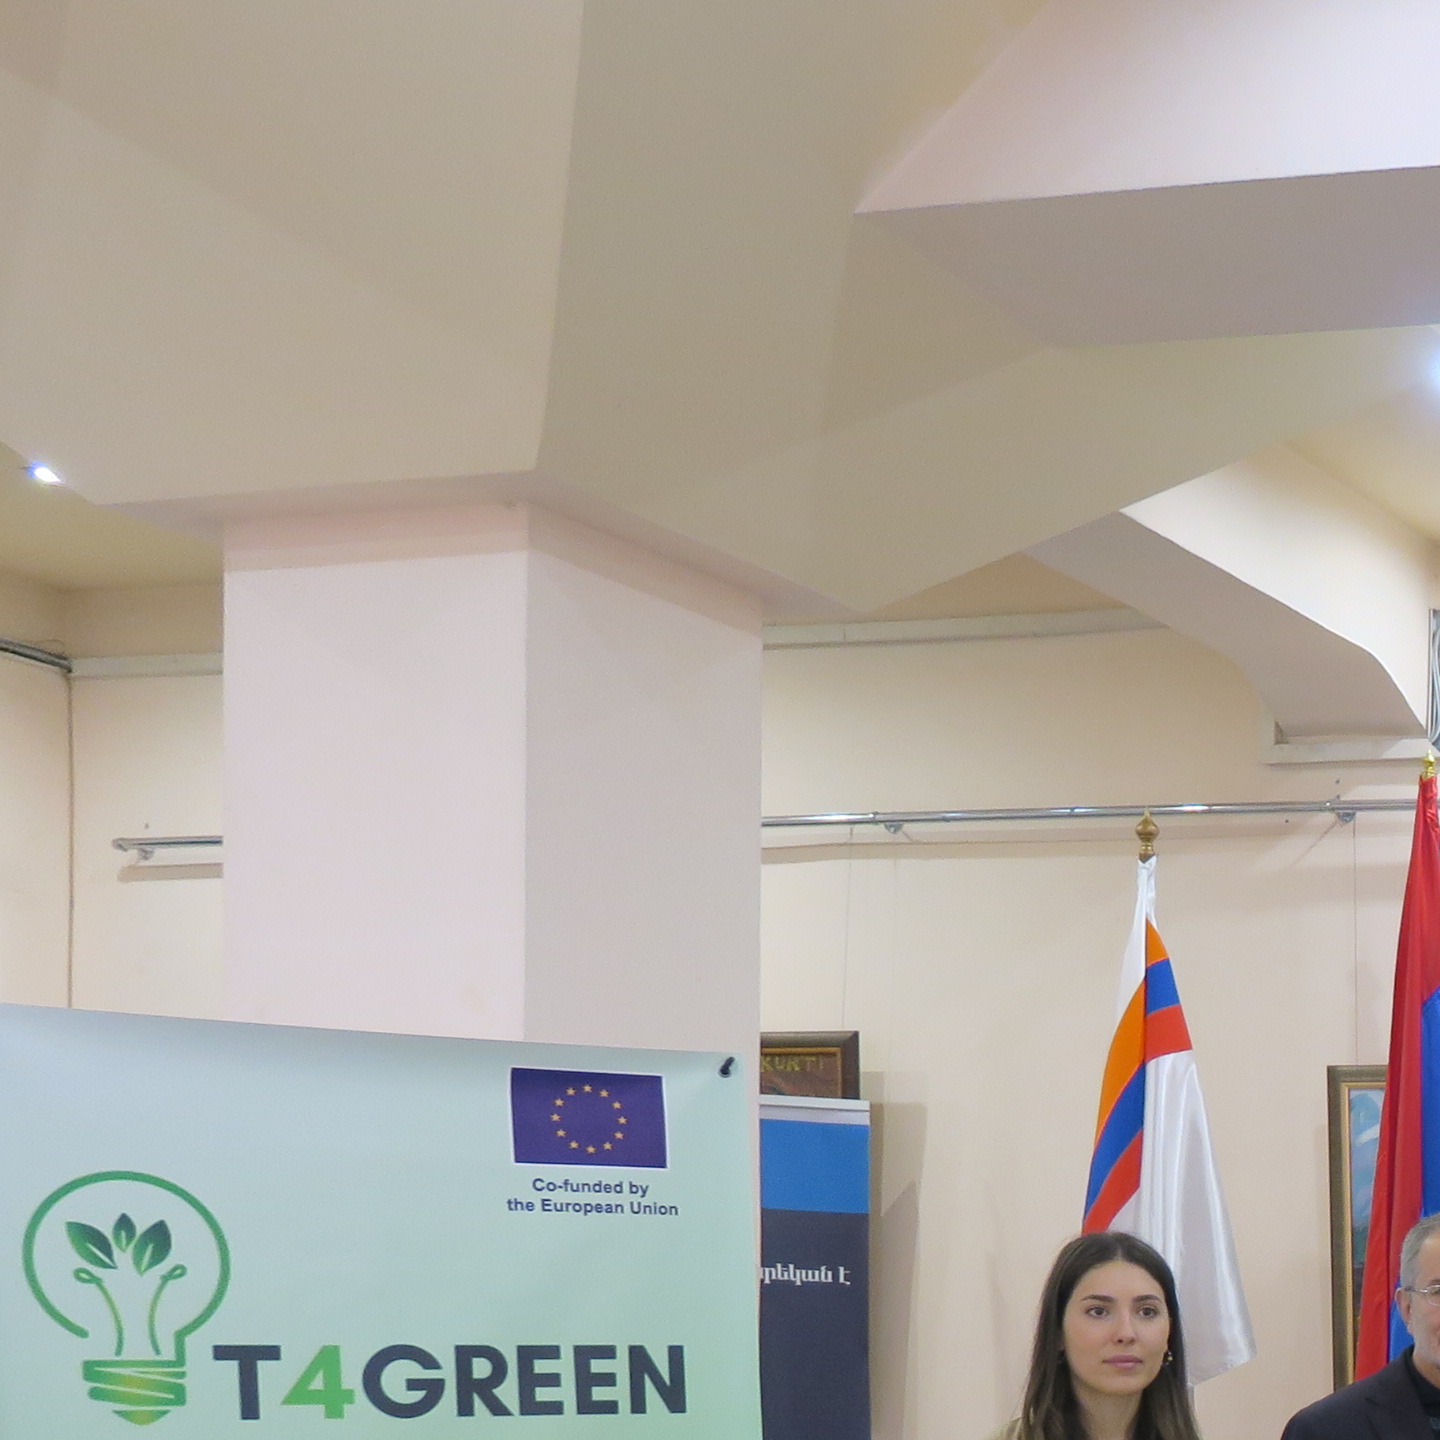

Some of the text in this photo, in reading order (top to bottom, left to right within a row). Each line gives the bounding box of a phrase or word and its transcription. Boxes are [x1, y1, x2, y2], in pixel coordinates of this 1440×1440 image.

[532, 1177, 650, 1198] Co-funded by
[507, 1198, 679, 1216] the European Union
[212, 1344, 688, 1420] T4GREEN
